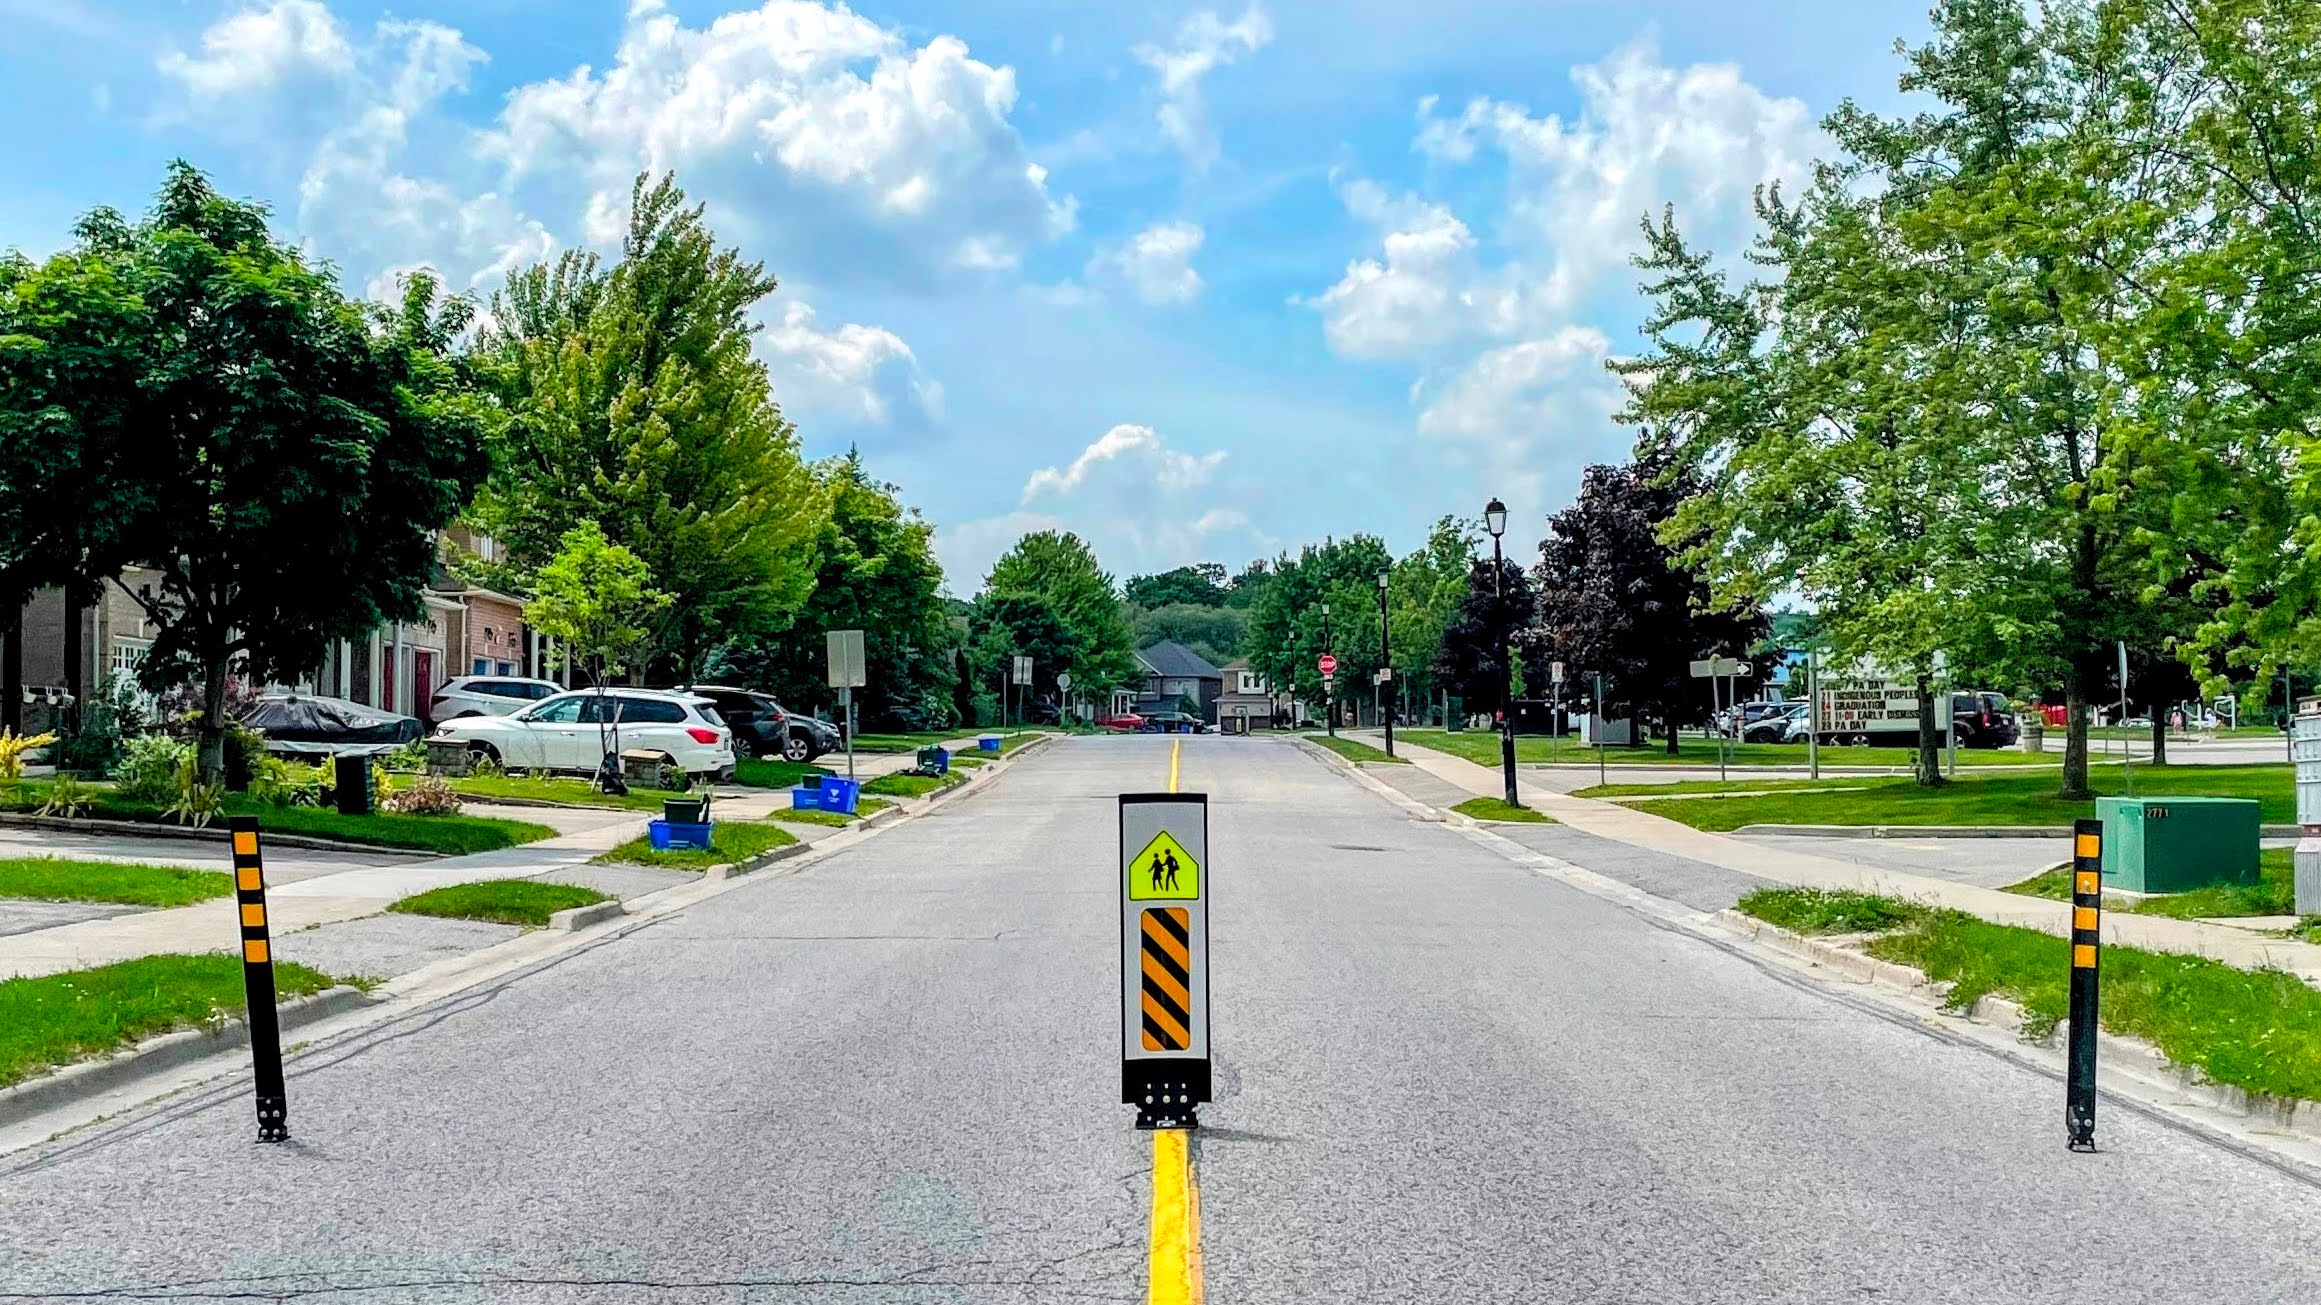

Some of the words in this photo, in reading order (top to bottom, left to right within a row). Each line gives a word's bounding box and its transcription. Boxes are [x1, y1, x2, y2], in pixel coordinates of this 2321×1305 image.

[1868, 680, 1885, 690] DAY
[1834, 700, 1886, 710] GRADUATION
[1857, 710, 1882, 719] EARLY
[1834, 721, 1846, 730] PA
[1850, 720, 1867, 730] DAY
[2146, 807, 2169, 818] 2771
